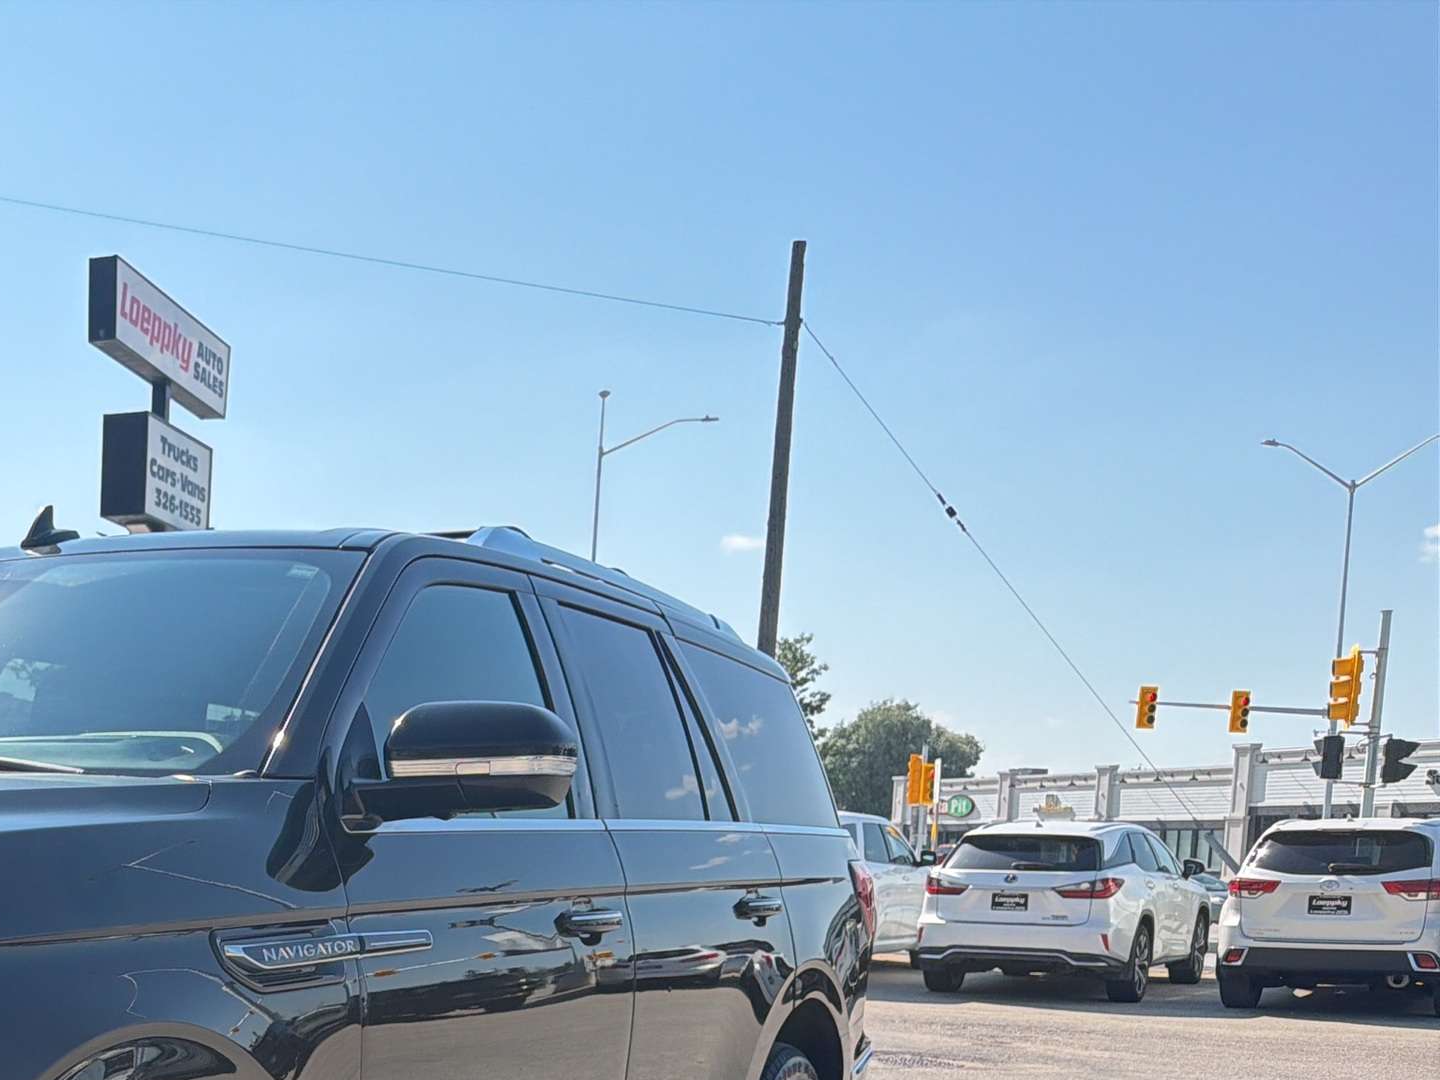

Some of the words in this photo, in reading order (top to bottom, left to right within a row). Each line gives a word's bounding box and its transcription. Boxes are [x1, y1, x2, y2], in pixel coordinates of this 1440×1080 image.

[120, 281, 193, 373] Loeppky
[196, 341, 224, 376] AUTO
[192, 361, 224, 398] SALES
[160, 435, 198, 473] Trucks
[262, 939, 357, 963] NAVIGATOR
